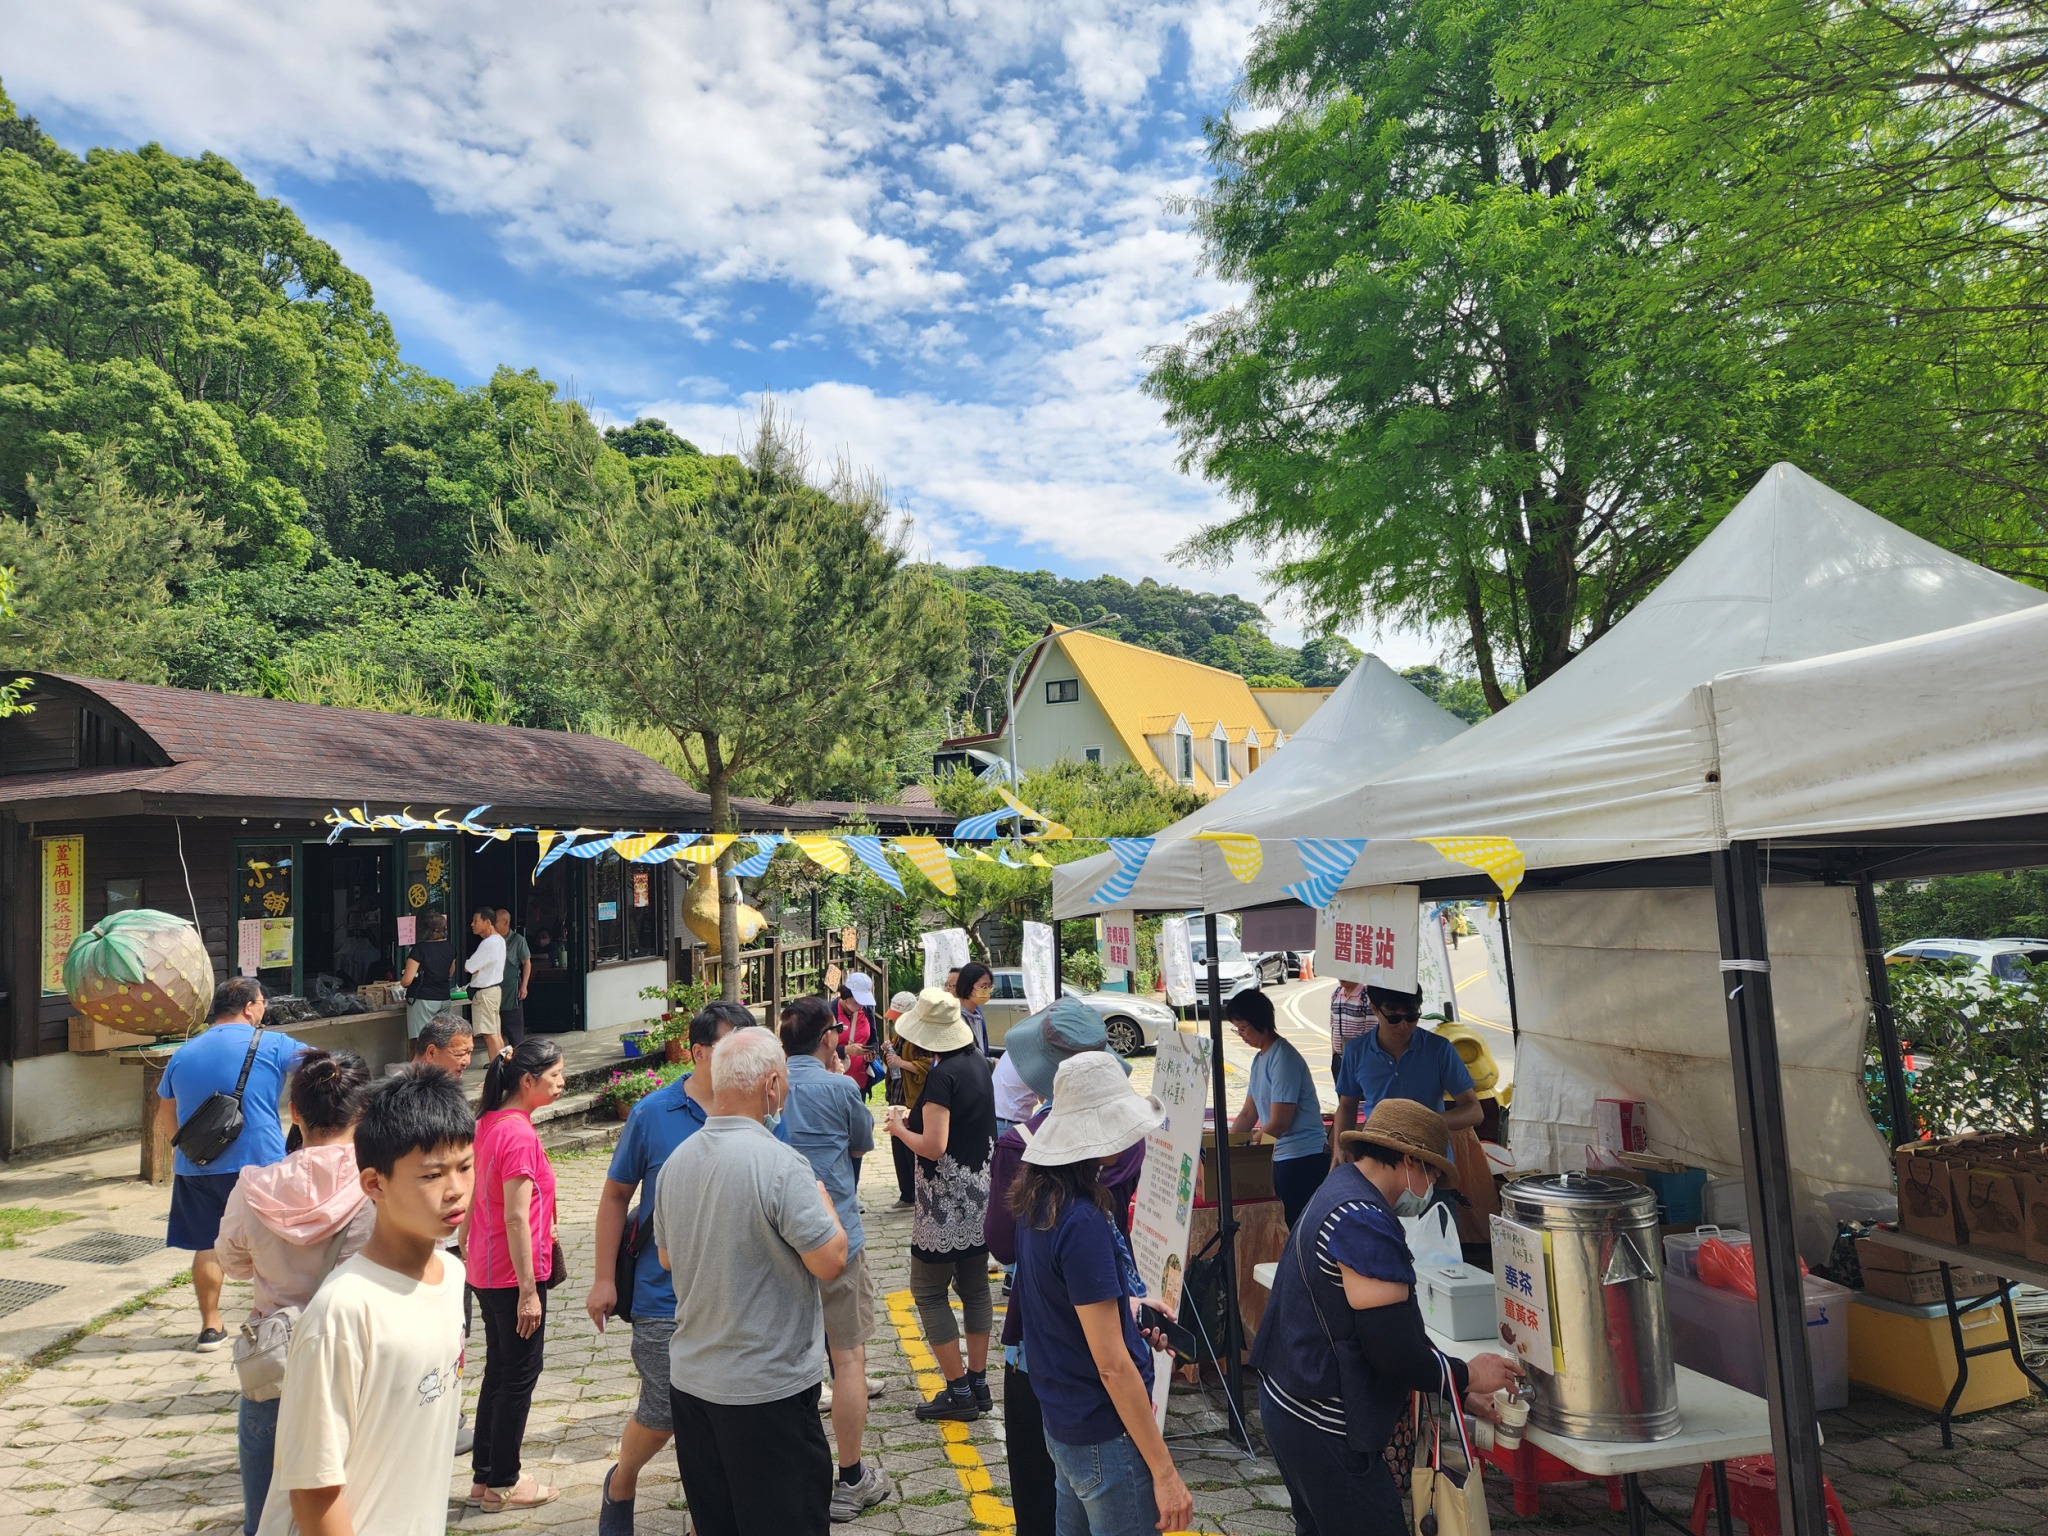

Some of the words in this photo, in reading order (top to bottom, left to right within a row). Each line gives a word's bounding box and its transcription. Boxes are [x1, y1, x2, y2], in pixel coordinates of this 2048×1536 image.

[1335, 922, 1395, 969] 醫護站
[1504, 1264, 1533, 1298] 奉茶
[1503, 1297, 1539, 1331] 薑黃茶
